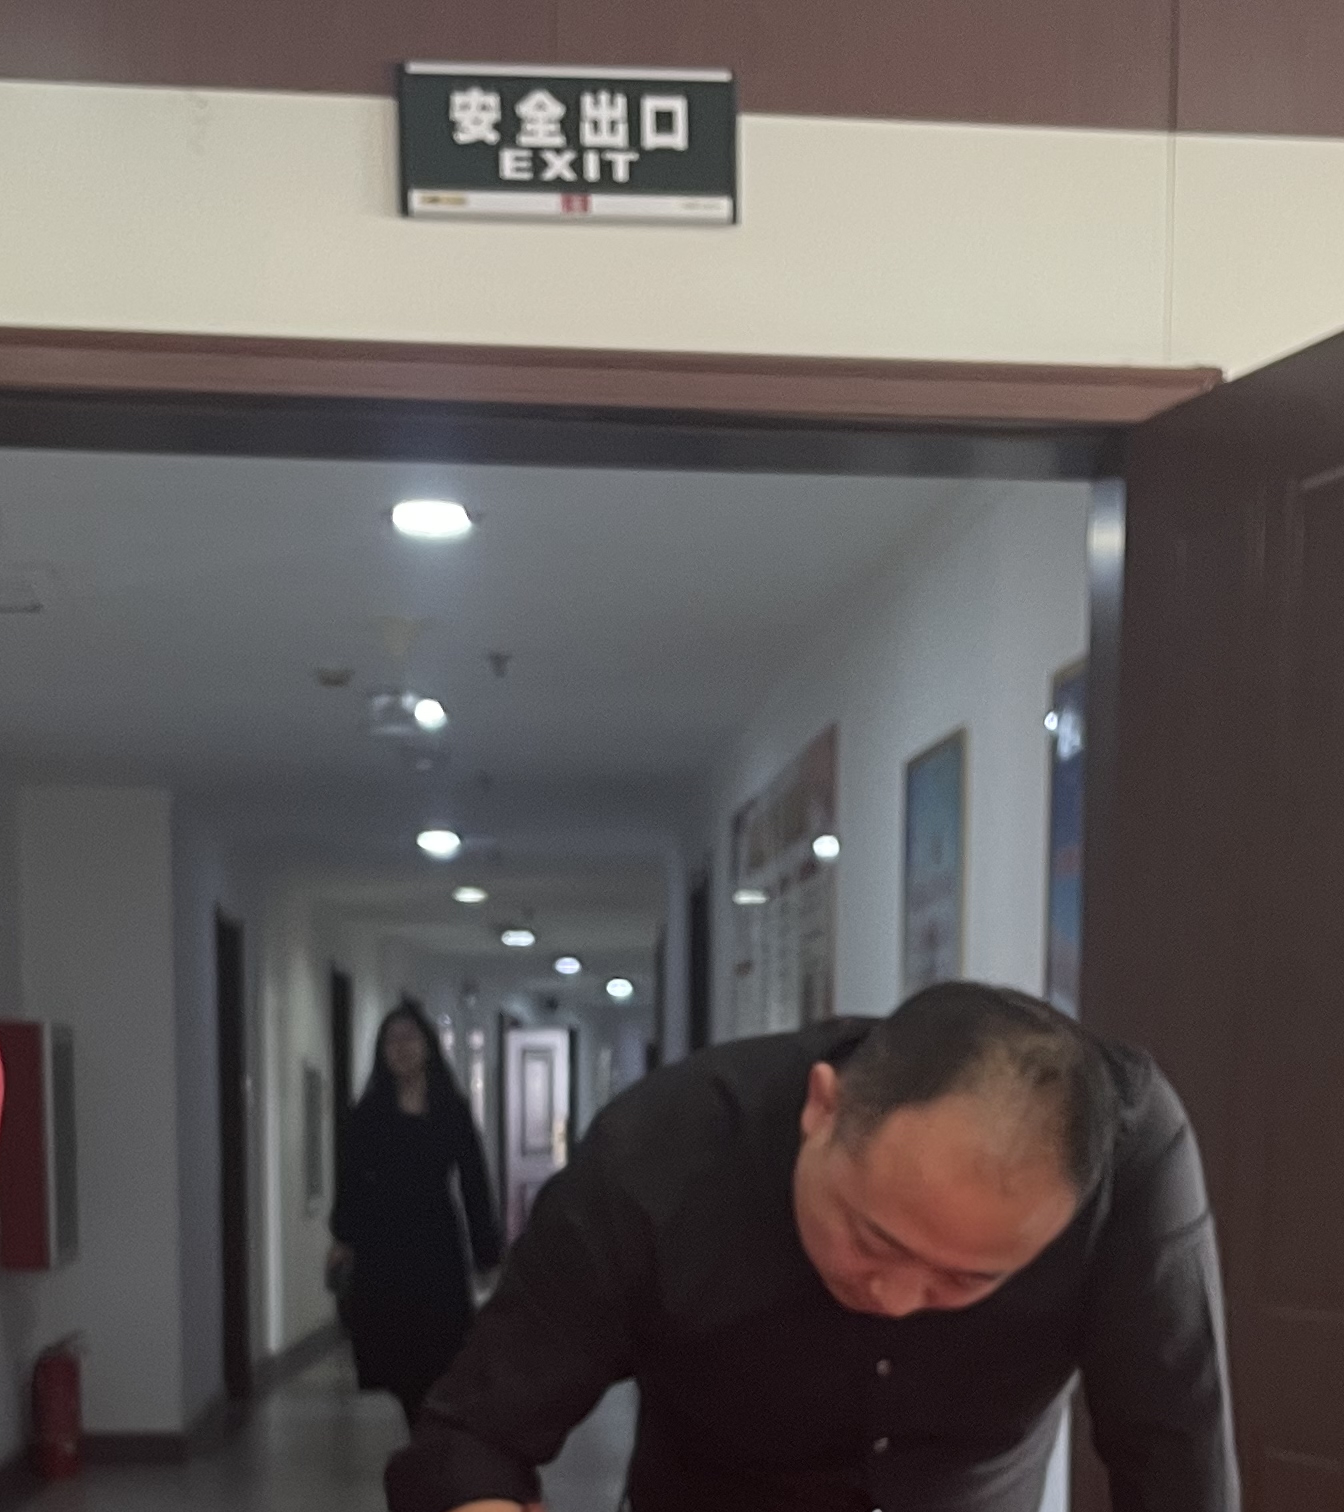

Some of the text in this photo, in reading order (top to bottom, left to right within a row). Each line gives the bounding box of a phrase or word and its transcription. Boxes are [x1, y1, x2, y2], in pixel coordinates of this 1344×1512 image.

[449, 86, 689, 151] 安全出口
[498, 147, 640, 183] EXIT
